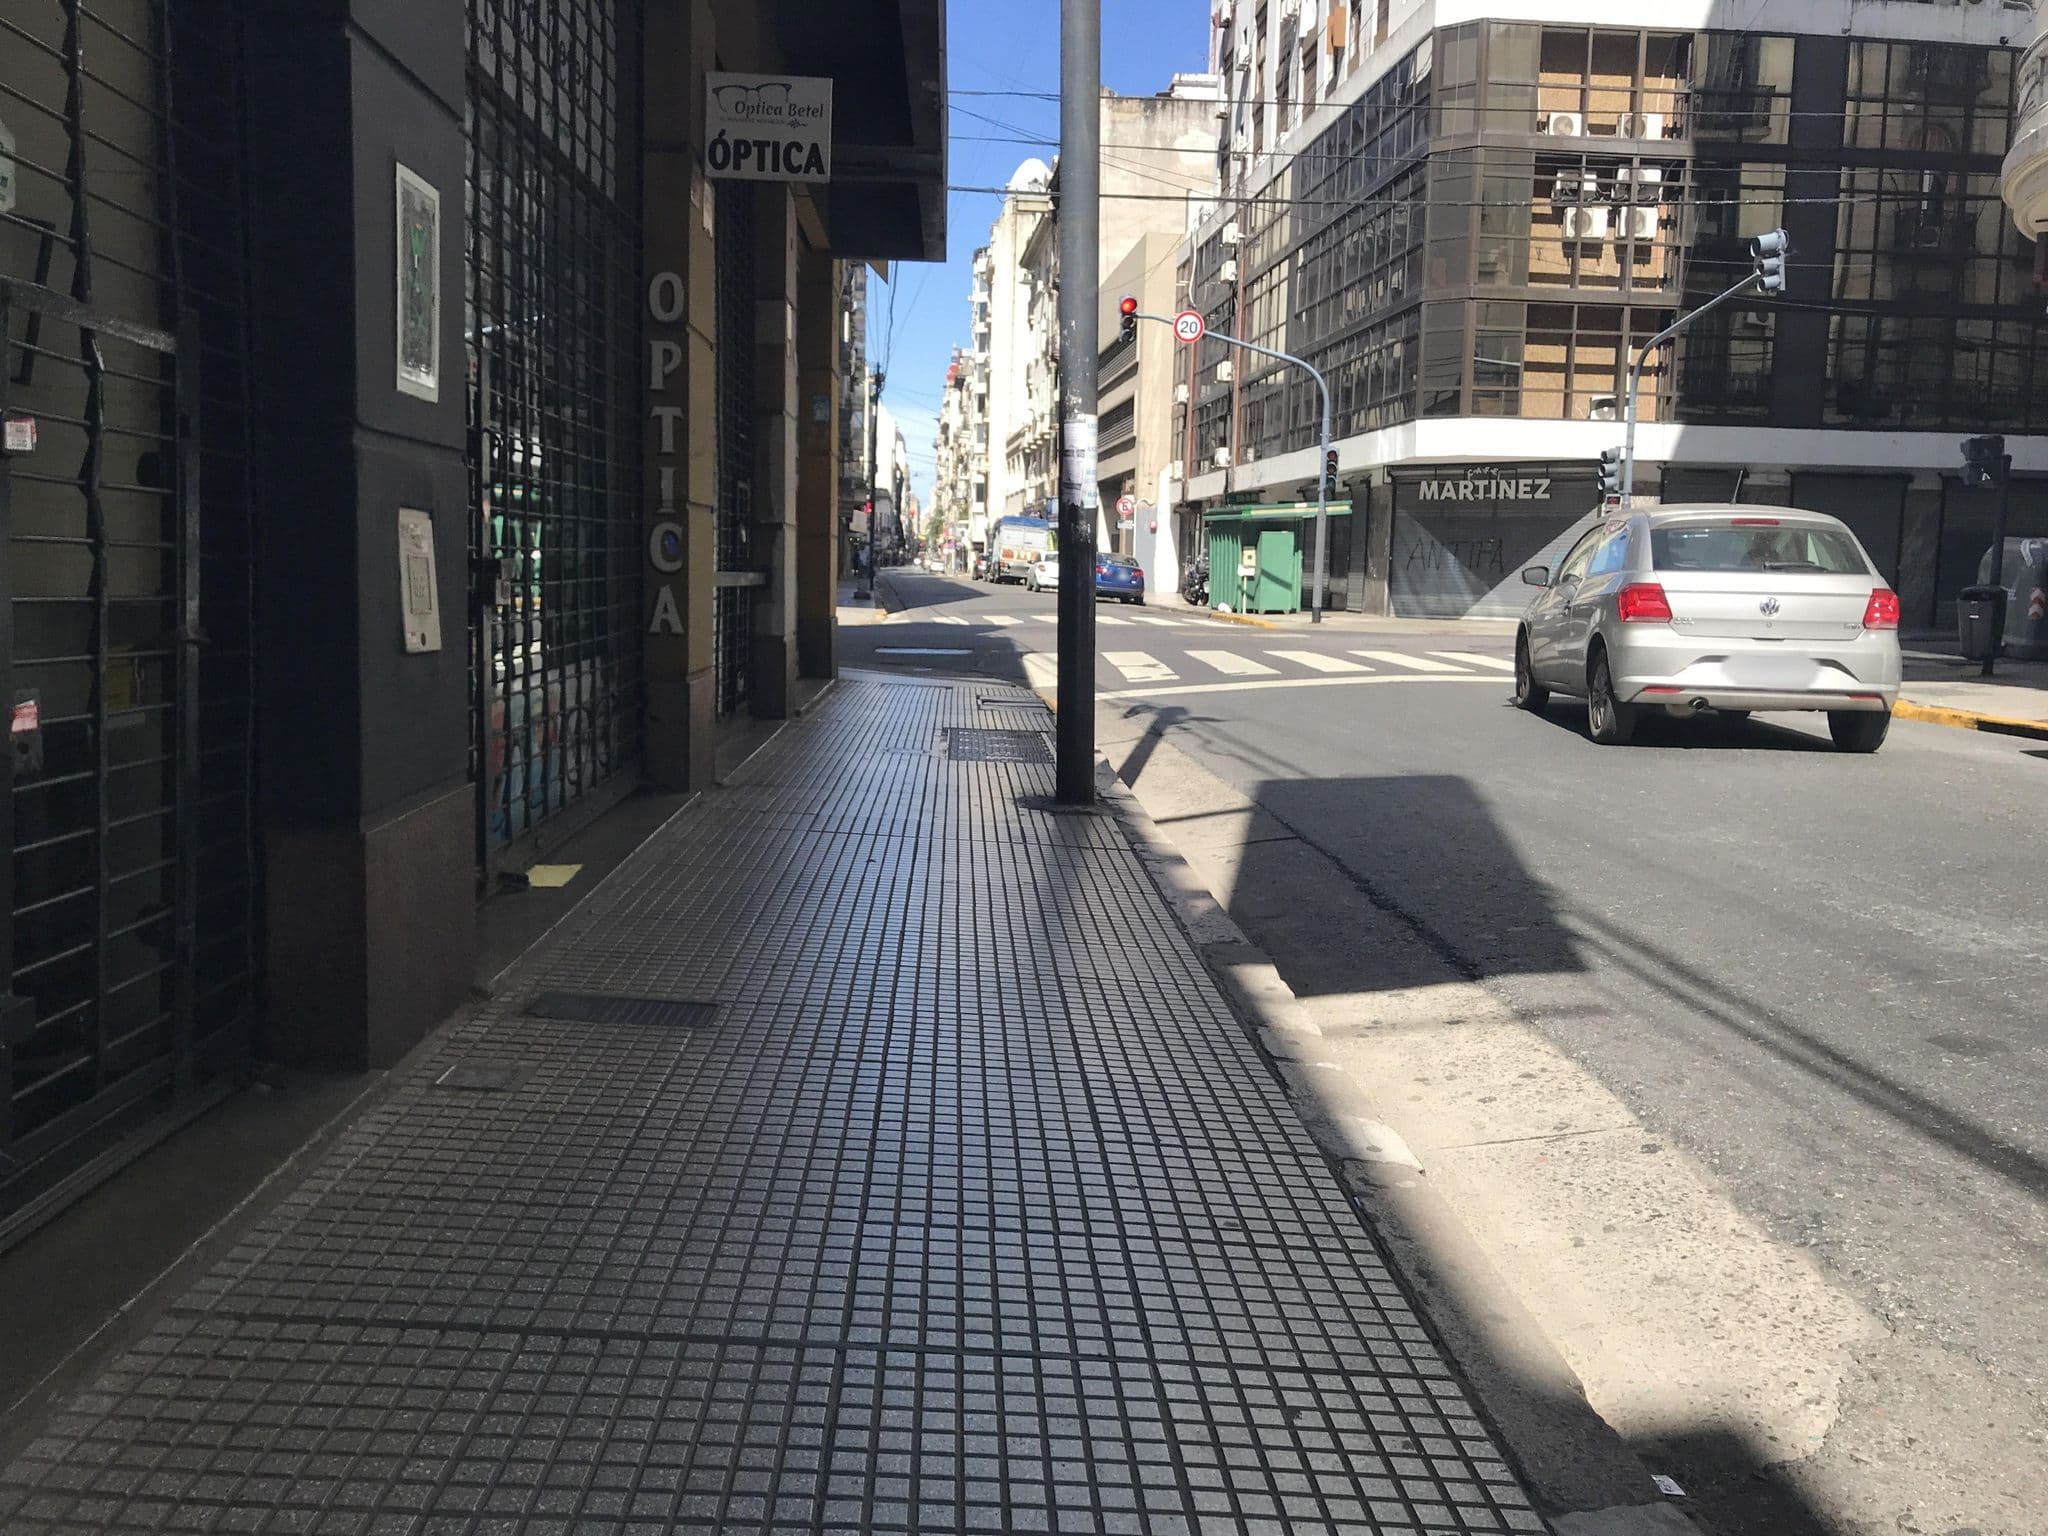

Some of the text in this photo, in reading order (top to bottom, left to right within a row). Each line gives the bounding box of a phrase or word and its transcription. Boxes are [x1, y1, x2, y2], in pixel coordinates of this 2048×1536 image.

[734, 100, 824, 118] Optica Betel
[708, 128, 826, 175] ÓPTICA
[1180, 320, 1198, 334] 20
[649, 271, 686, 636] OPTICA
[1418, 478, 1551, 501] MARTINEZ
